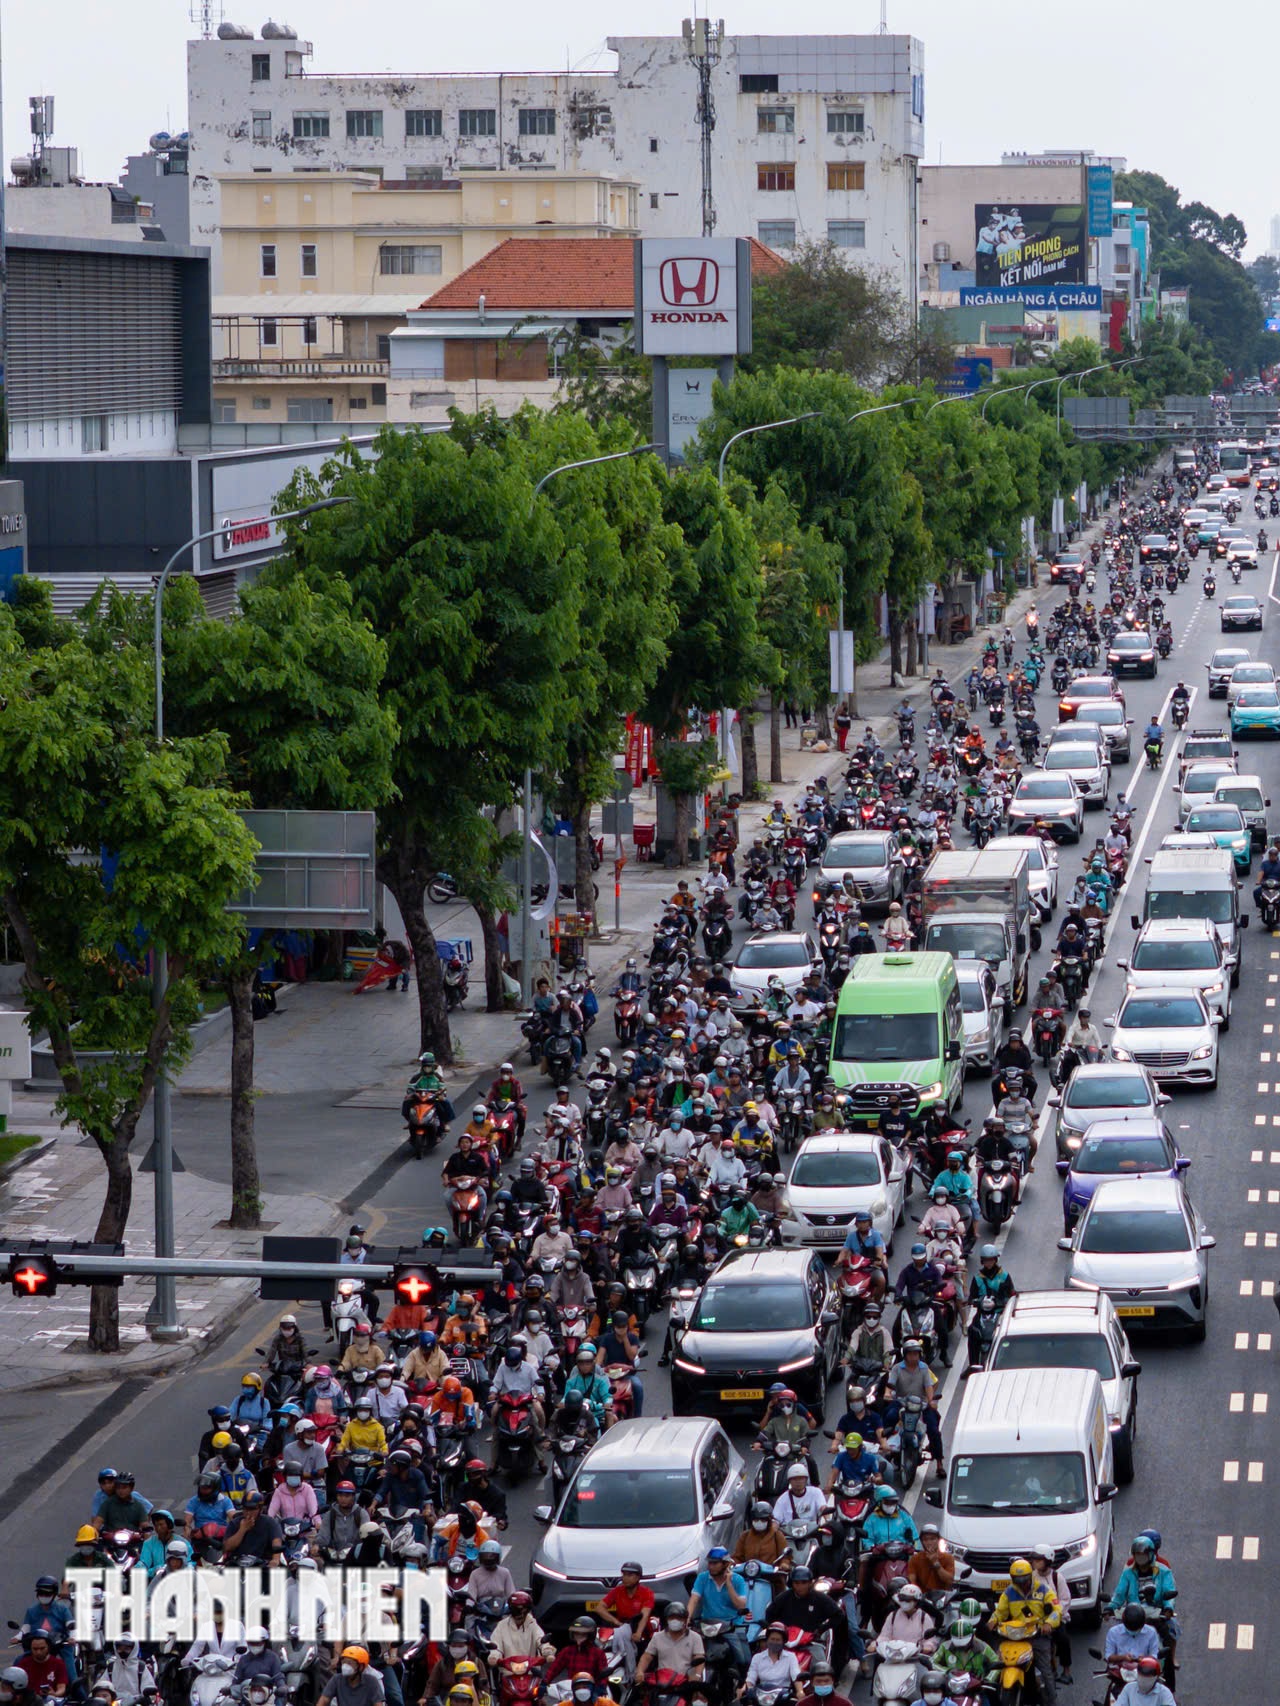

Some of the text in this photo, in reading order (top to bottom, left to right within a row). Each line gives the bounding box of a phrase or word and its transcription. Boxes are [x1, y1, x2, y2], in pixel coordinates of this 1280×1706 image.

[1024, 236, 1061, 261] PHONG
[1043, 245, 1080, 263] PHONG CÁCH
[1000, 257, 1042, 287] KẾT NỐI
[965, 292, 1097, 305] NGÂN HÀNG Á CHÂU
[651, 313, 728, 323] HONDA
[2, 514, 25, 533] TOWER
